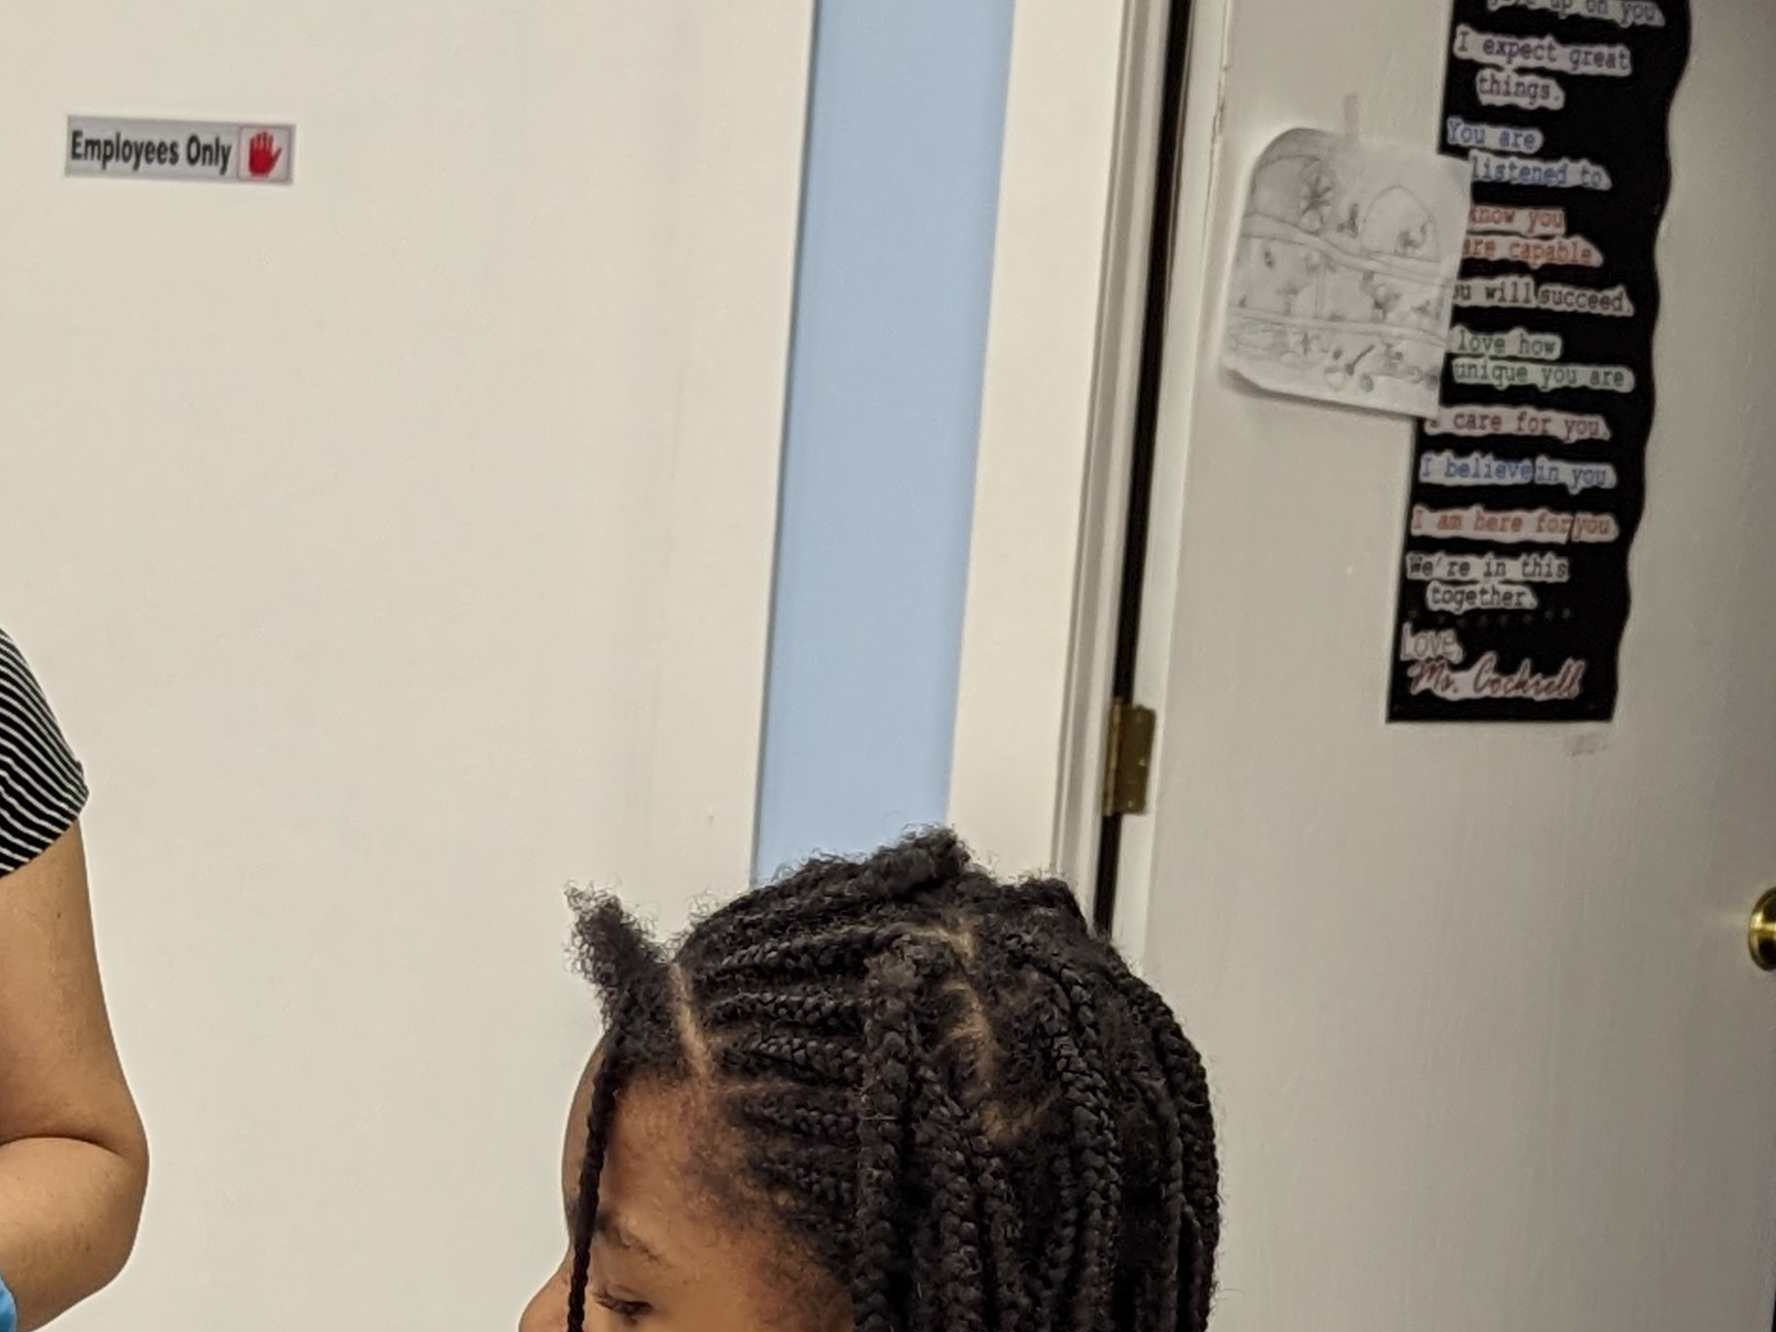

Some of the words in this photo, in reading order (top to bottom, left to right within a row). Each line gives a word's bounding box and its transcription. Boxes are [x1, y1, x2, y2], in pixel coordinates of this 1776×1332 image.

[1621, 2, 1656, 25] you
[1457, 31, 1469, 52] I
[1482, 37, 1558, 63] expect
[1569, 49, 1630, 71] great
[1478, 73, 1561, 104] things.
[1447, 120, 1486, 145] You
[1498, 130, 1537, 148] are
[70, 130, 180, 172] Employees
[185, 134, 233, 176] Only
[1471, 156, 1568, 184] listened
[1581, 163, 1603, 187] to
[1528, 210, 1565, 233] you
[1508, 241, 1592, 266] capable
[1484, 281, 1534, 304] will
[1459, 329, 1506, 352] love
[1519, 332, 1556, 355] how
[1453, 359, 1528, 387] unique
[1540, 366, 1578, 389] you
[1589, 369, 1625, 387] are
[1453, 411, 1503, 431] care
[1516, 410, 1553, 433] for
[1421, 456, 1432, 477] I
[1444, 457, 1534, 479] believe
[1536, 458, 1560, 481] in
[1412, 508, 1423, 530] I
[1436, 512, 1463, 531] am
[1473, 510, 1523, 533] here
[1535, 512, 1571, 535] for
[1408, 555, 1472, 578] We're
[1482, 555, 1507, 578] in
[1521, 556, 1569, 579] this
